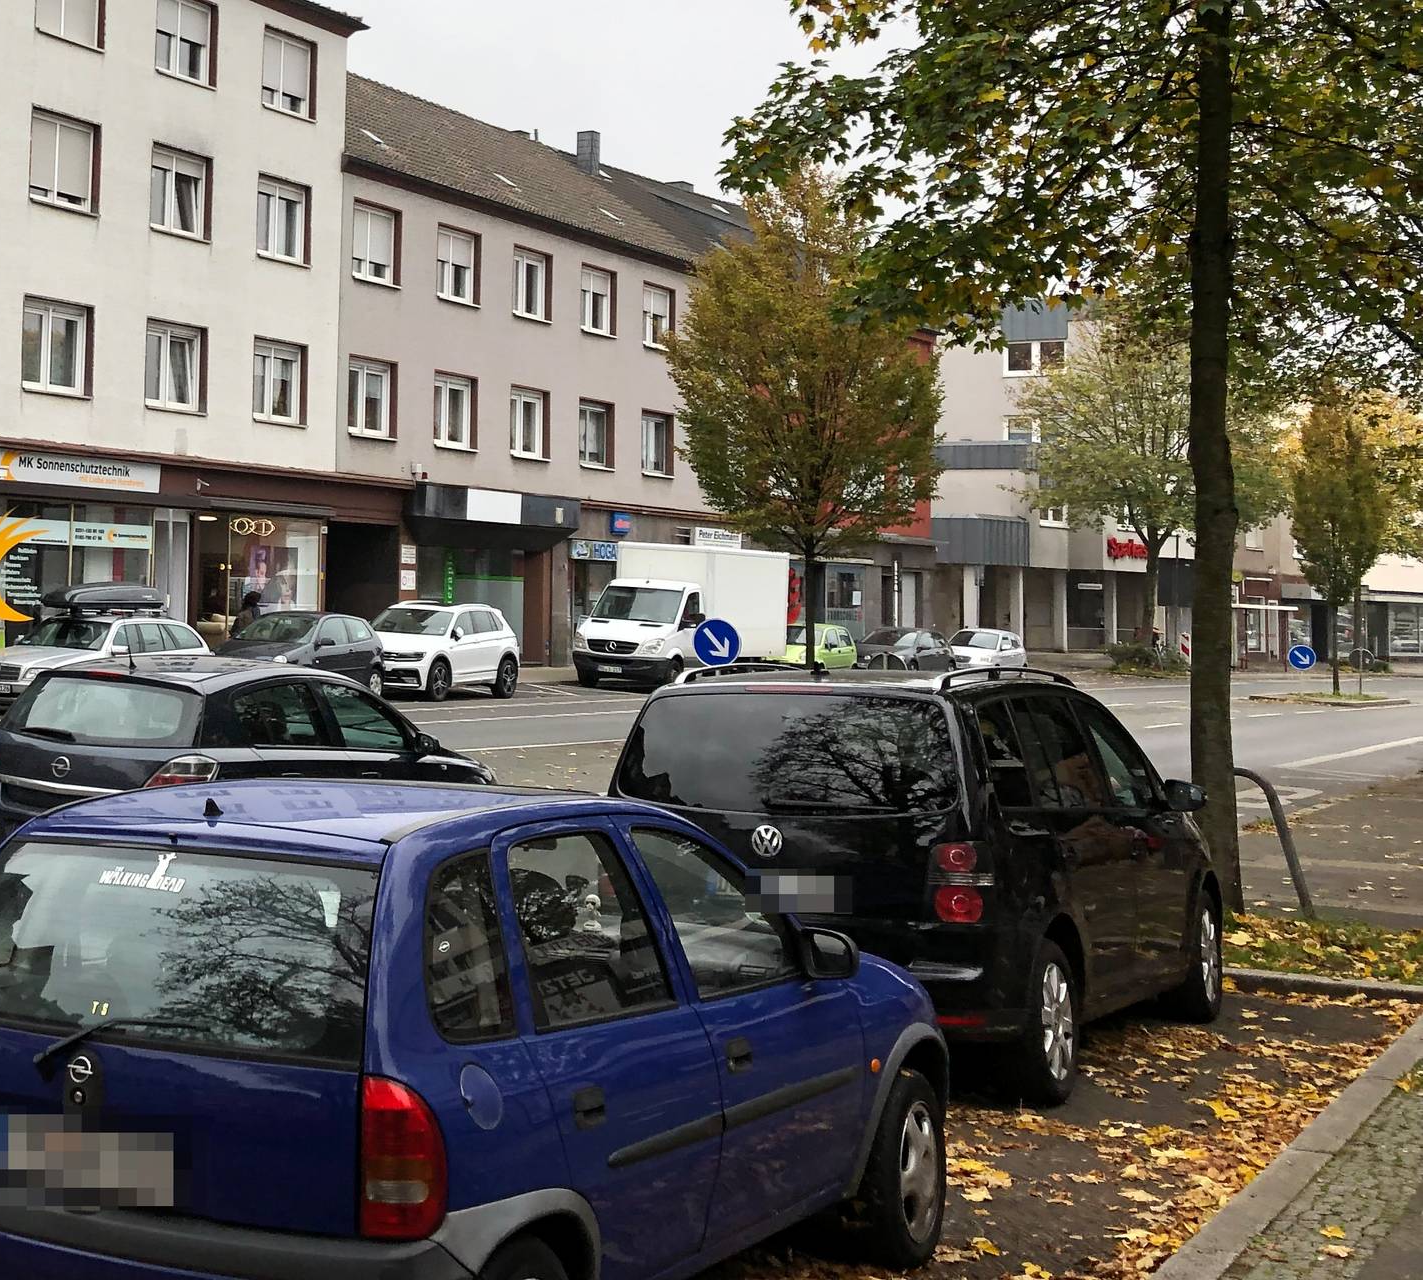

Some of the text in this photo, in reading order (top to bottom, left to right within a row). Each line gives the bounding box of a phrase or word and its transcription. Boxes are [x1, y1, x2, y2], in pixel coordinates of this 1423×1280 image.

[18, 456, 131, 478] MK Sonnenschutztechnik
[698, 529, 713, 539] Peter
[98, 870, 150, 888] WALKING
